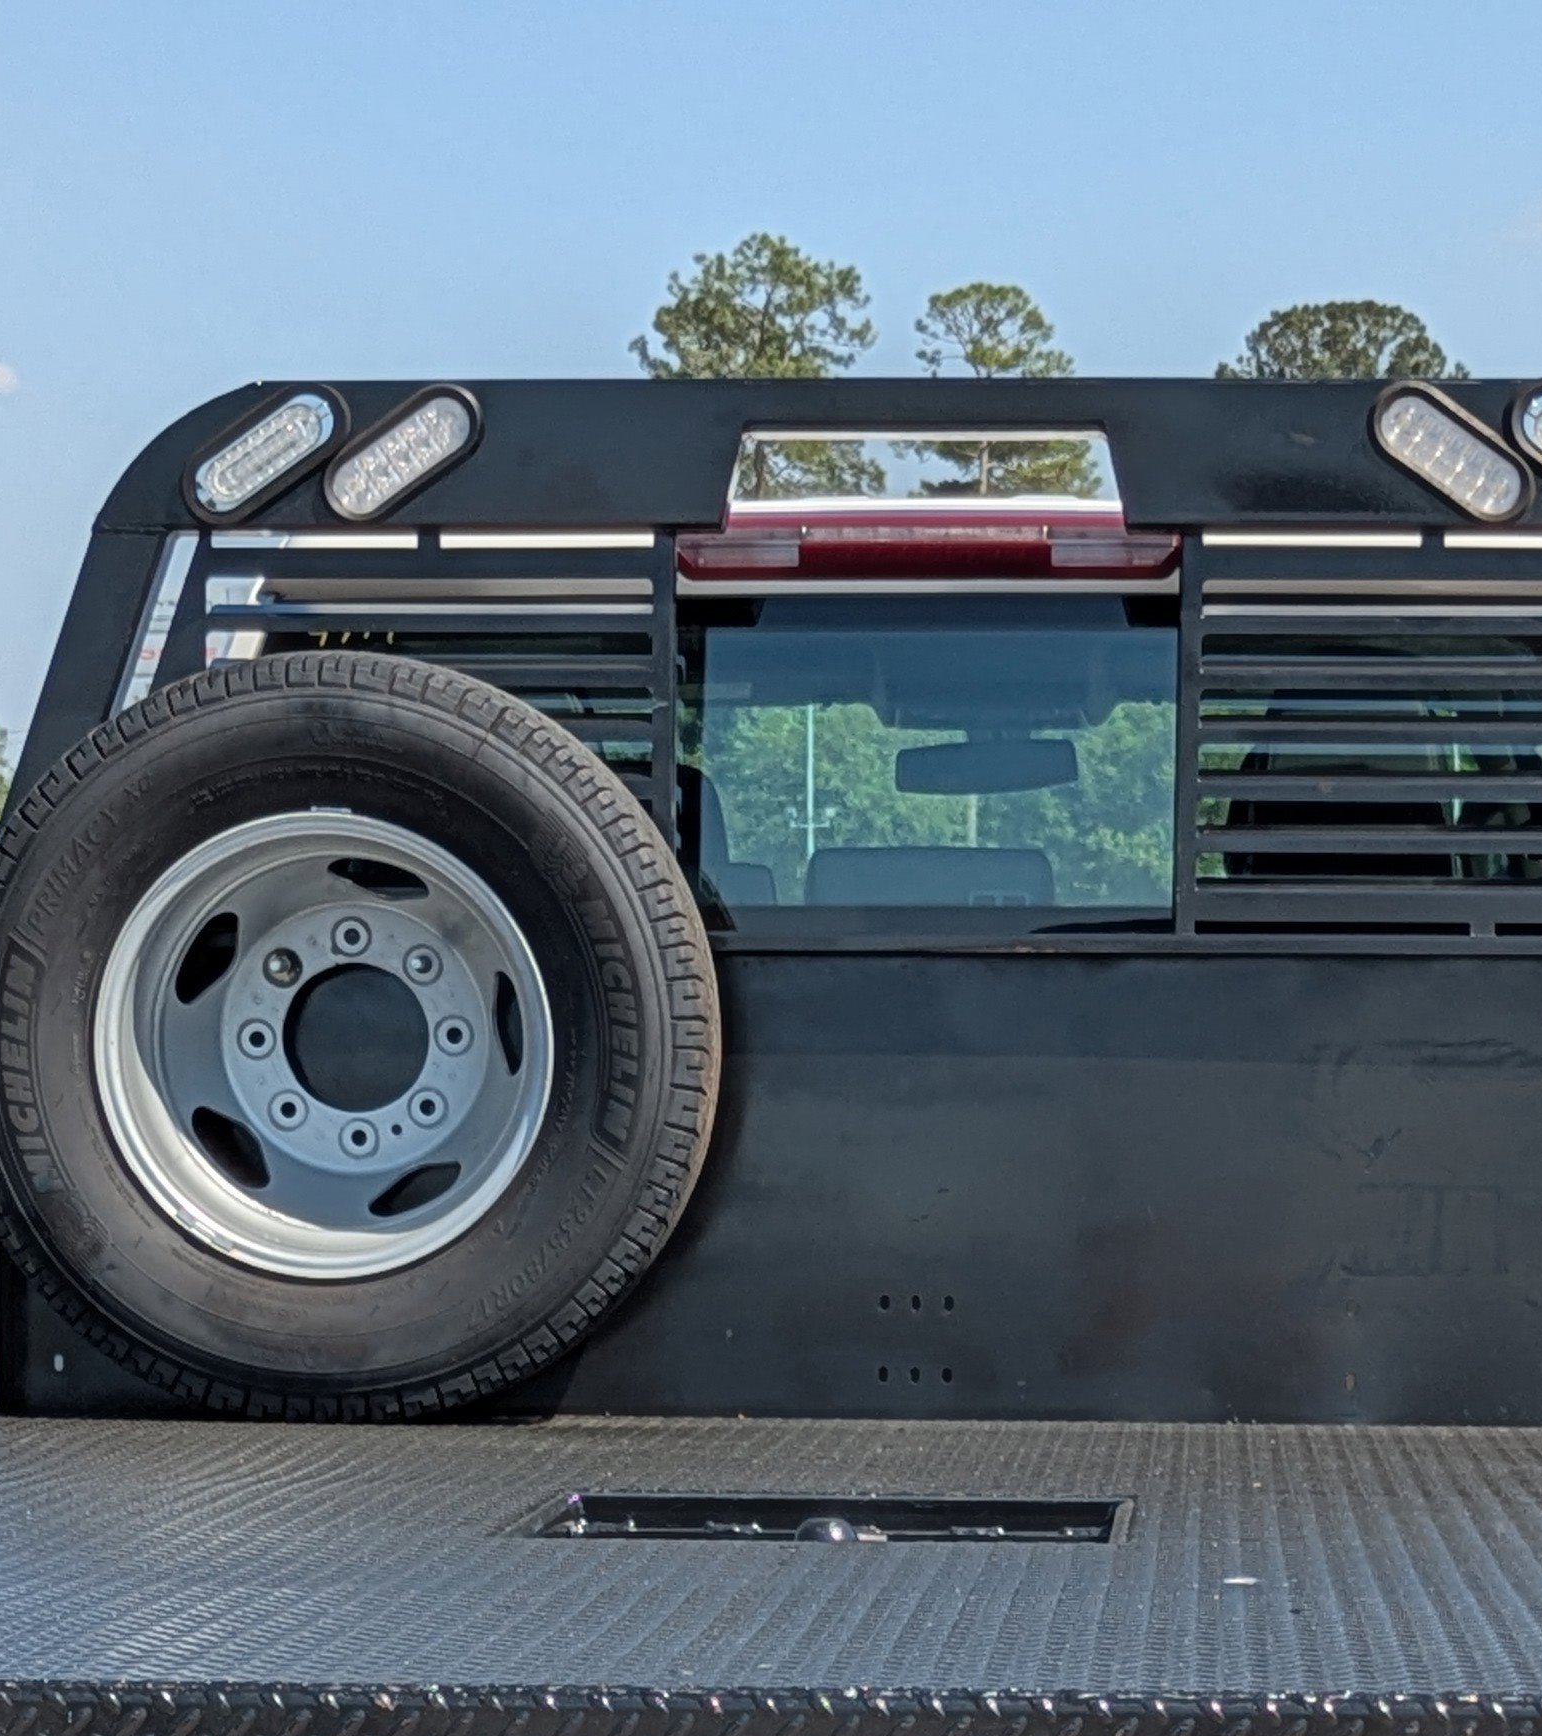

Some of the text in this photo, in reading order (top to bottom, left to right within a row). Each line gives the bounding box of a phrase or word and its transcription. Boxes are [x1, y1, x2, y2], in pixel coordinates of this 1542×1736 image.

[23, 806, 119, 938] PRIMACY
[0, 952, 62, 1195] MICHELIN
[577, 899, 640, 1145] MICHELIN
